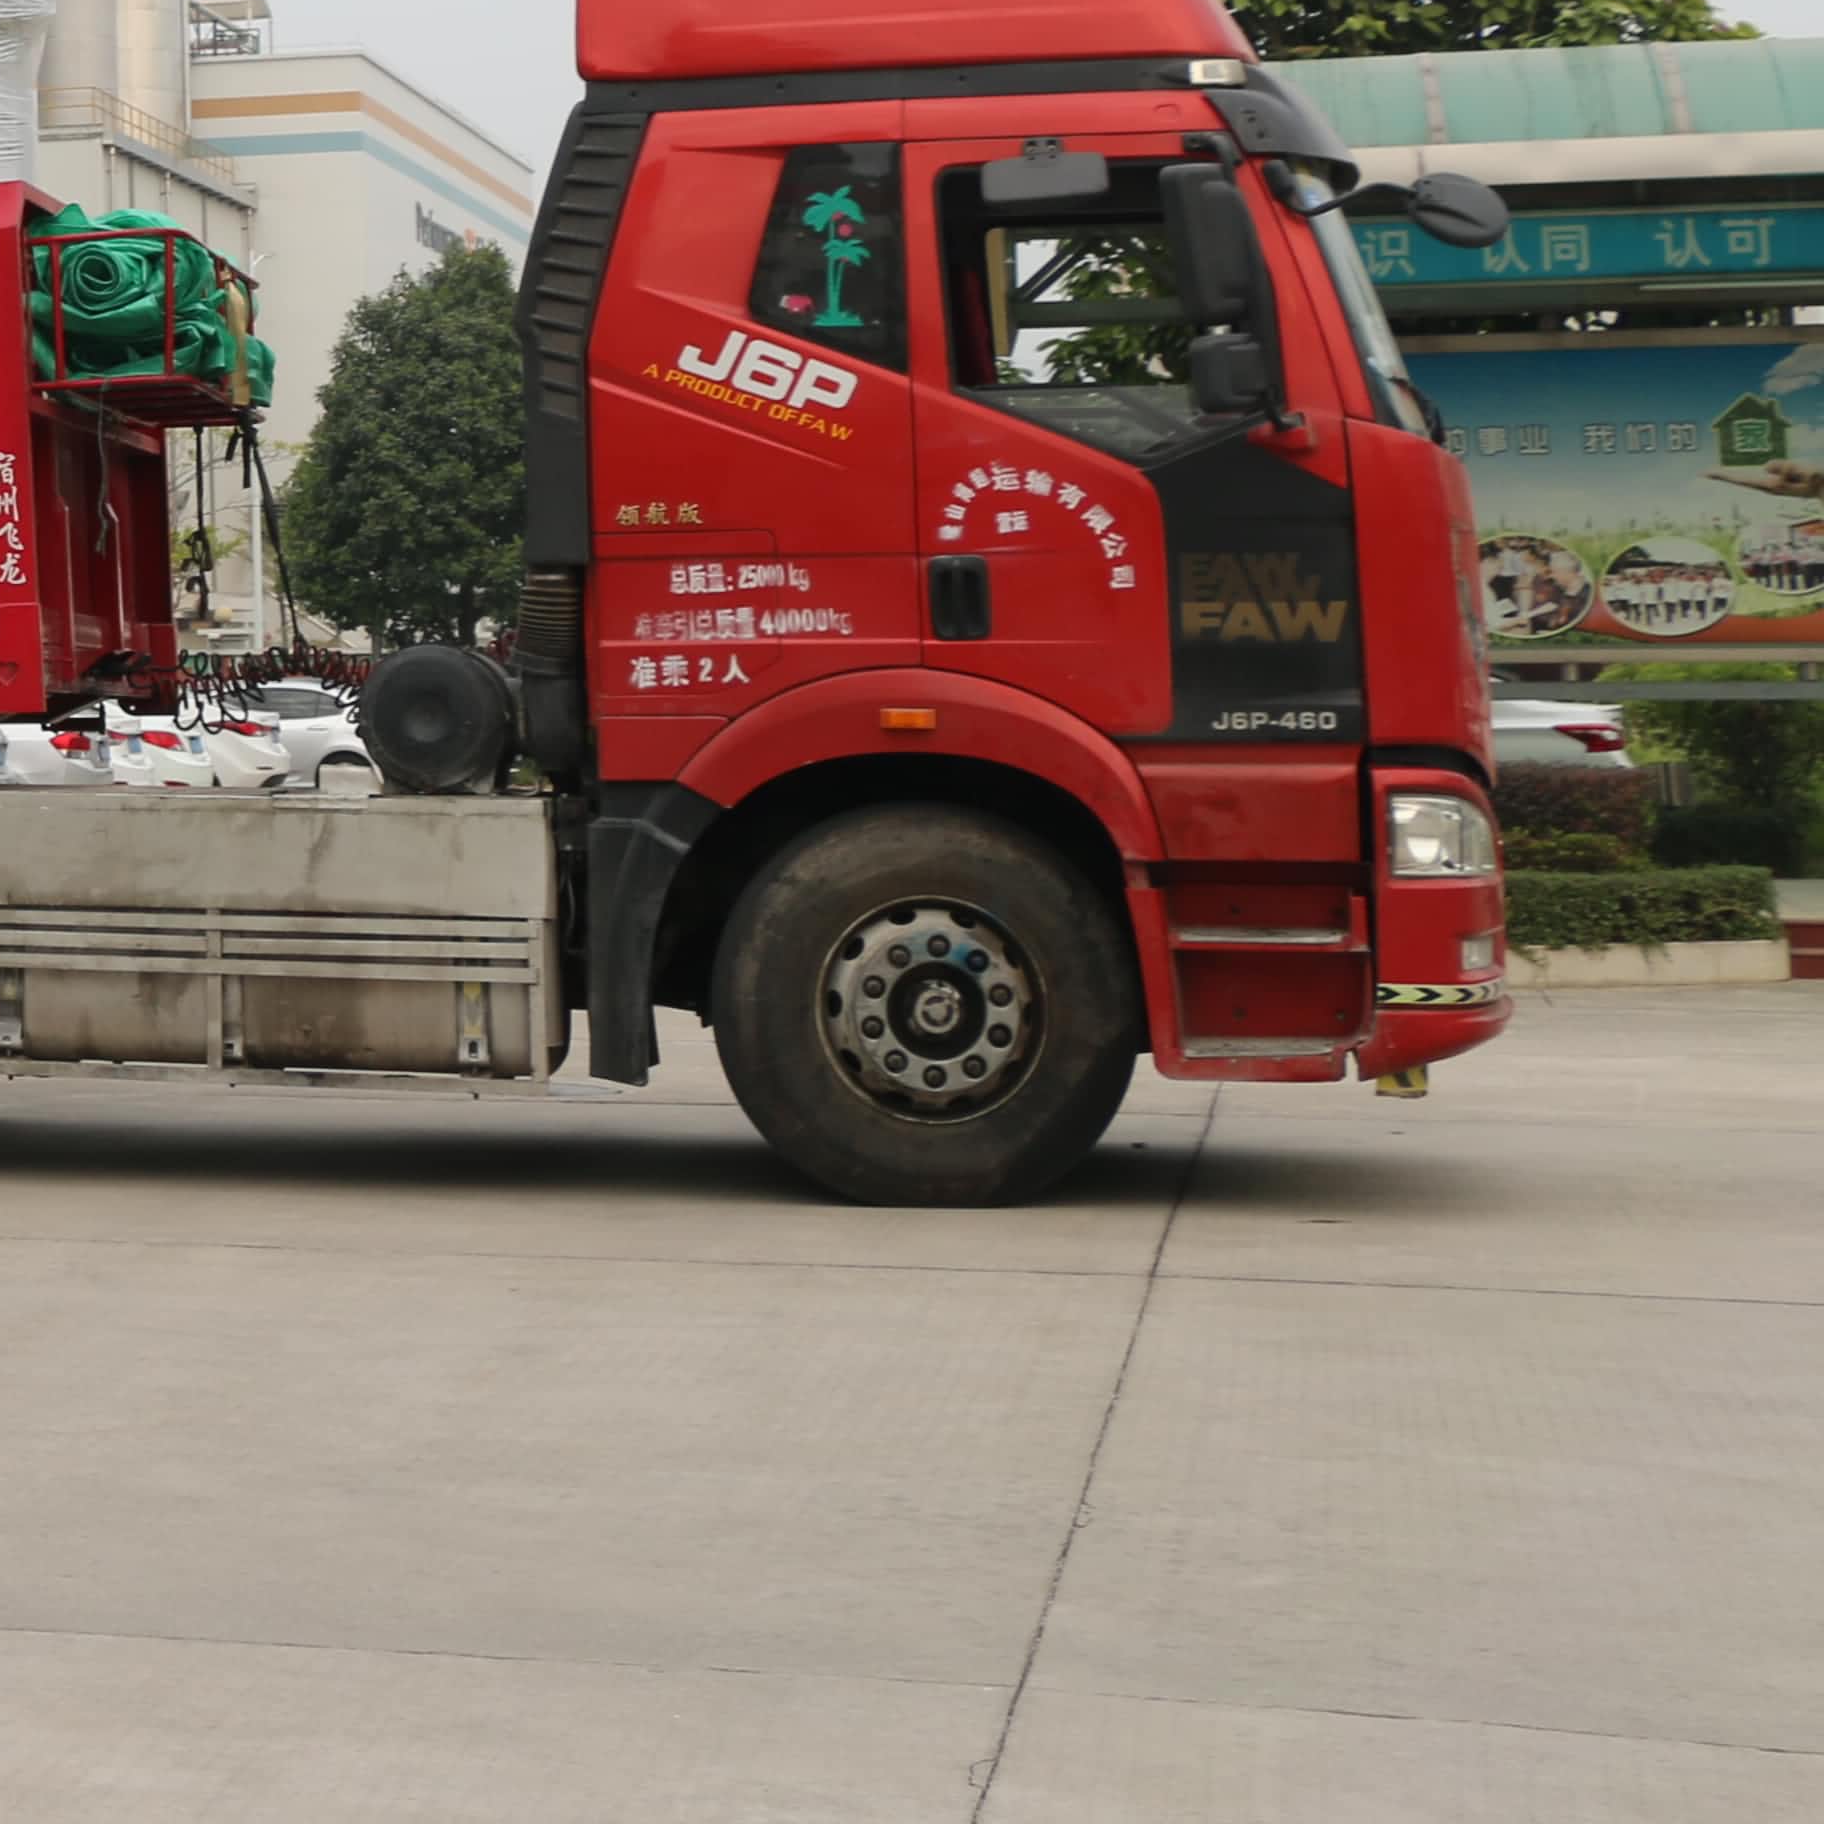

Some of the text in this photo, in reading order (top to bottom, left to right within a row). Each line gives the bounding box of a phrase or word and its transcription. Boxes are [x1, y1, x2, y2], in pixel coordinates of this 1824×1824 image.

[1361, 217, 1776, 277] 识 认同 认可
[642, 363, 661, 379] A
[664, 368, 764, 412] PRODUCT
[677, 329, 859, 410] J6P
[616, 501, 704, 526] 领航版
[1181, 600, 1349, 643] FAW
[1211, 711, 1337, 731] J6P-460
